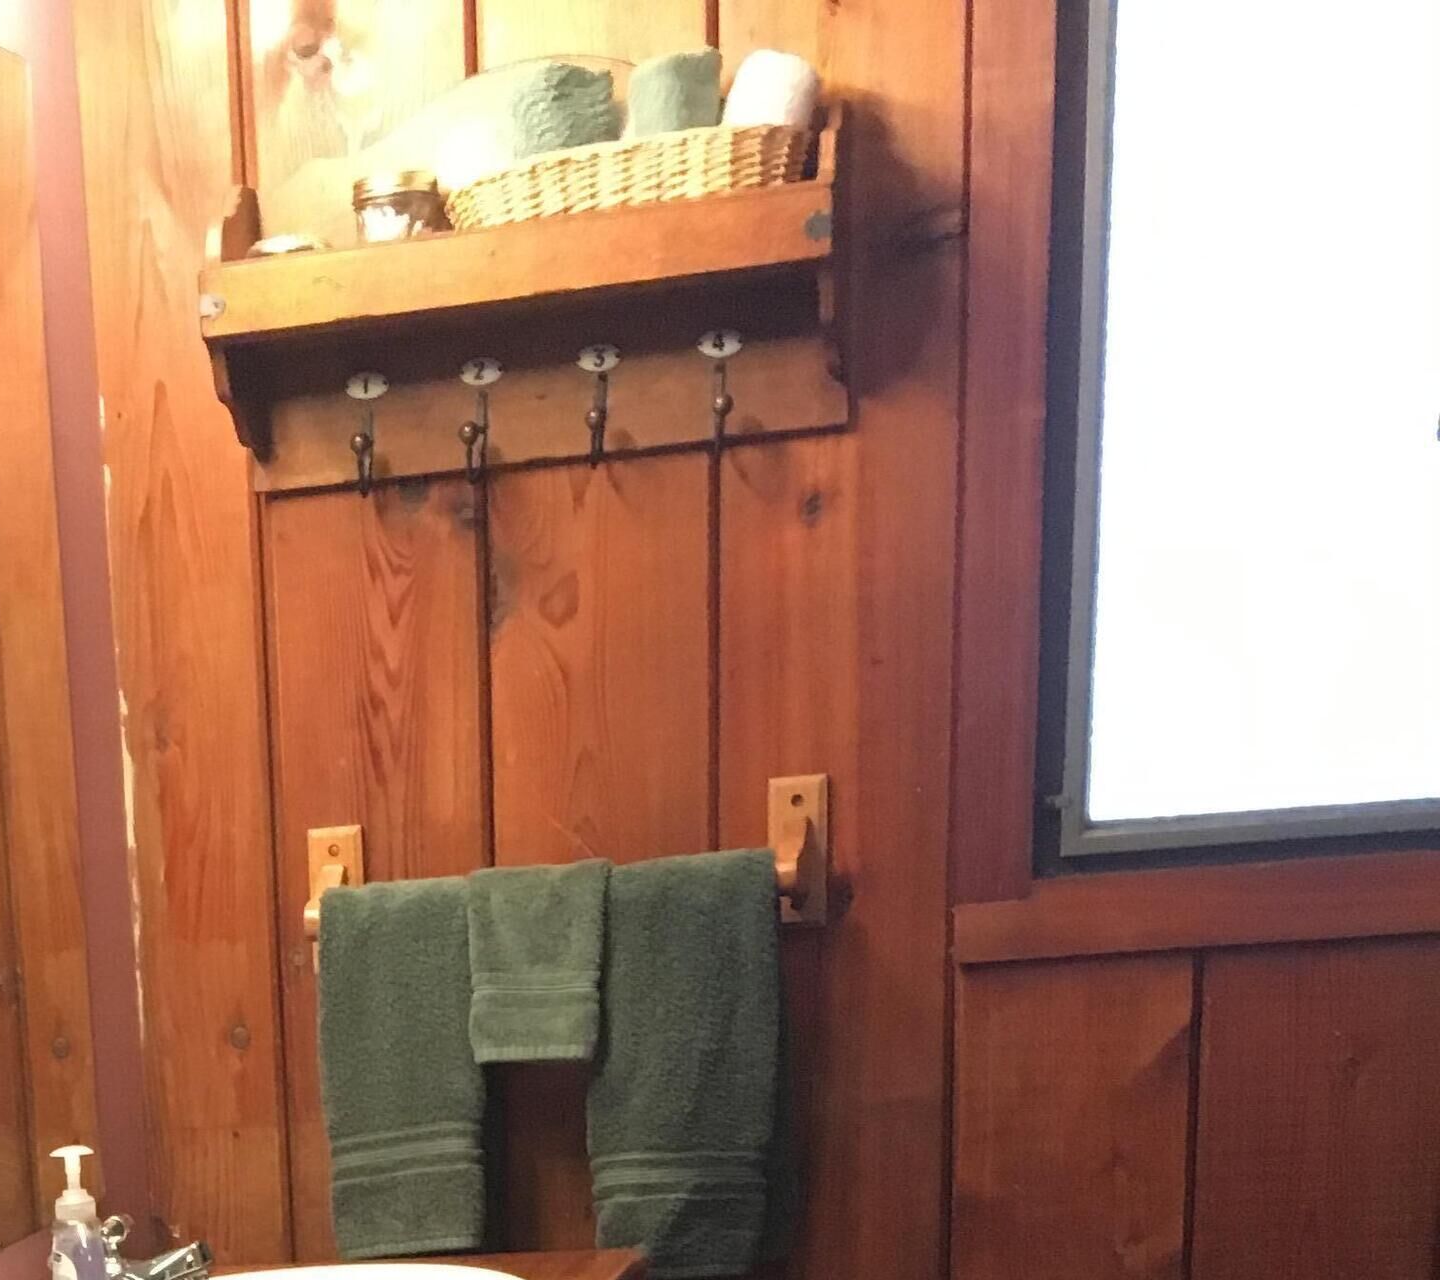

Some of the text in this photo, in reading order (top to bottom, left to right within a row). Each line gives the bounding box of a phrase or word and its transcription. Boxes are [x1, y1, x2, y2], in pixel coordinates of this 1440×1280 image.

[712, 333, 725, 352] 4
[593, 346, 606, 368] 3
[473, 361, 485, 381] 2
